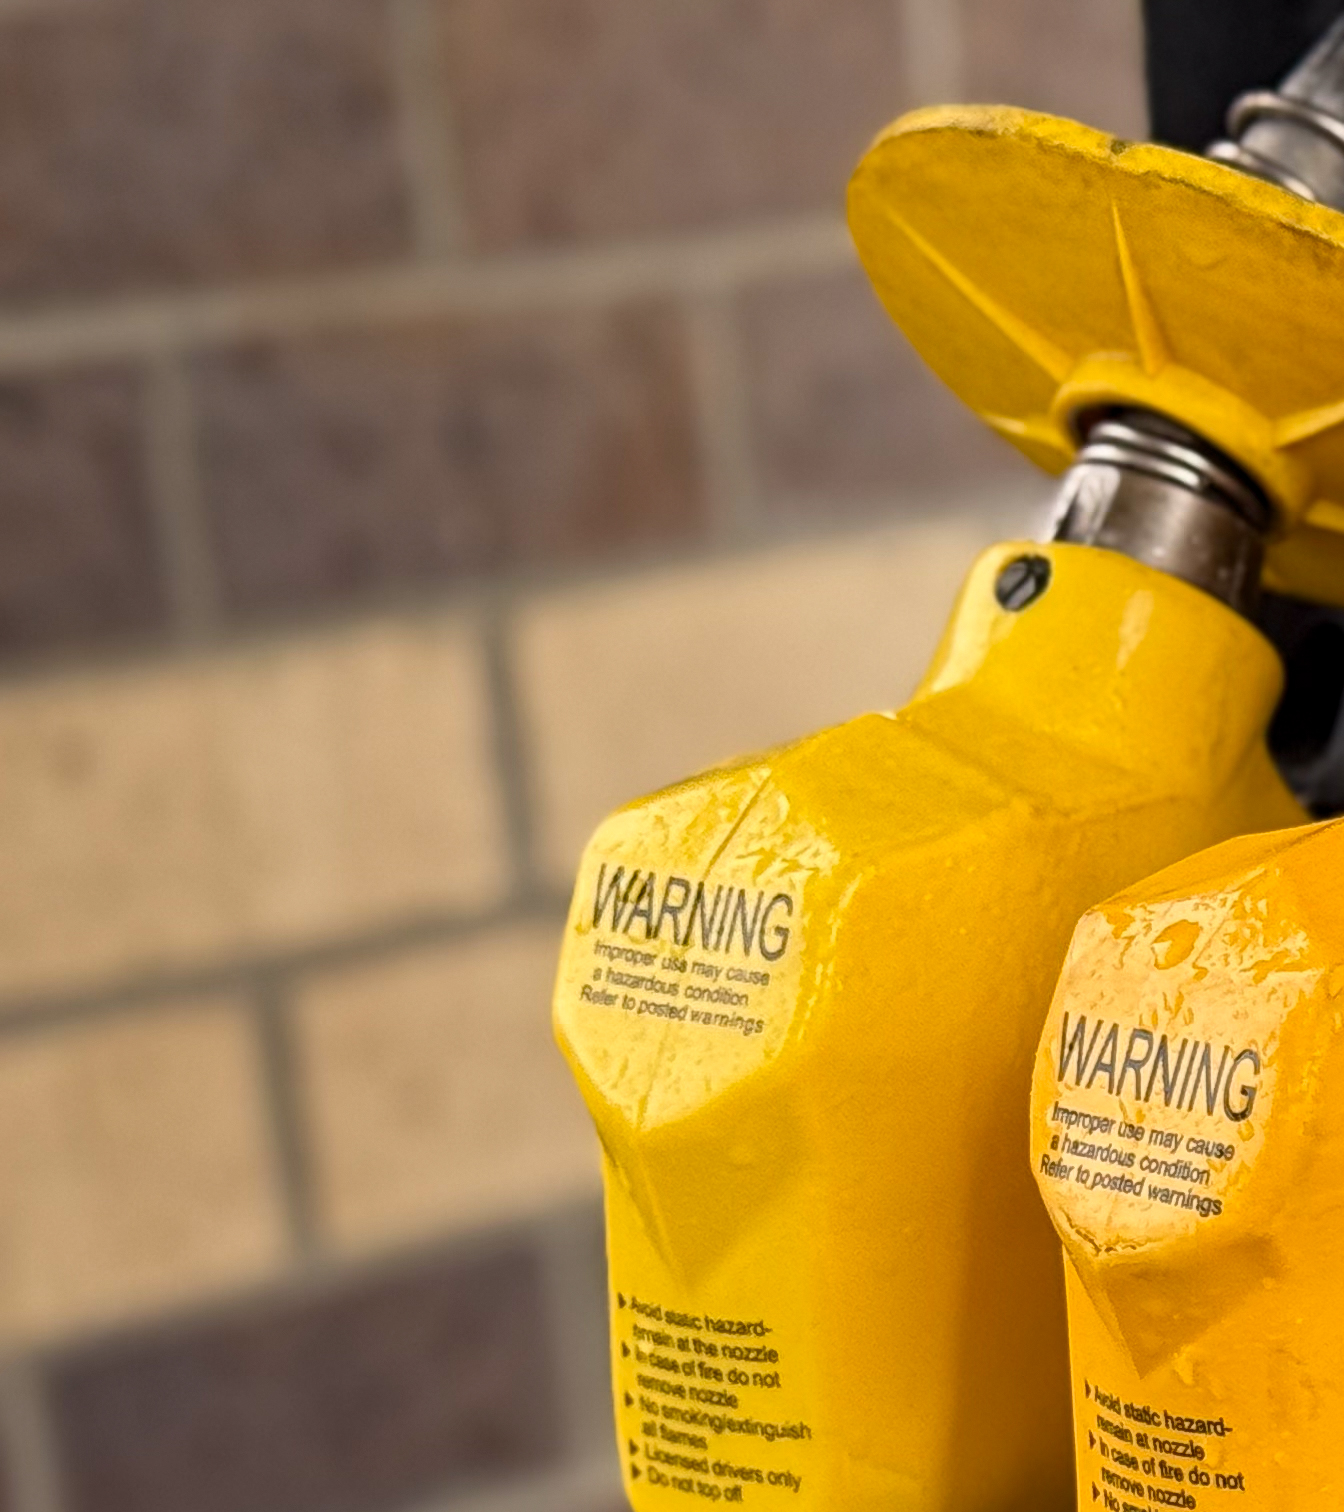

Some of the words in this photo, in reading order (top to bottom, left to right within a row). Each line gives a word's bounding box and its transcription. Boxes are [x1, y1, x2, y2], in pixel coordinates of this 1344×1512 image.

[592, 862, 794, 962] WARNING
[594, 940, 657, 967] Improper
[661, 955, 687, 973] use
[691, 958, 722, 982] may
[726, 967, 770, 986] cause
[593, 967, 602, 982] a
[605, 966, 680, 997] hazardous
[684, 985, 749, 1007] condition
[579, 983, 619, 1007] Refer
[622, 994, 636, 1010] to
[637, 998, 689, 1022] posted
[690, 1010, 764, 1036] warnings
[1057, 1011, 1261, 1122] WARNING
[1051, 1100, 1117, 1136] Improper
[1117, 1120, 1145, 1142] use
[1148, 1127, 1184, 1155] may
[1185, 1137, 1235, 1162] cause
[1050, 1134, 1060, 1150] a
[1061, 1133, 1136, 1169] hazardous
[1139, 1153, 1211, 1187] condition
[1040, 1154, 1075, 1179] Refer
[1075, 1167, 1089, 1184] to
[1092, 1172, 1146, 1197] posted
[1148, 1183, 1223, 1218] warnings
[704, 1315, 773, 1337] hazard-
[721, 1345, 780, 1363] nozzle
[688, 1386, 739, 1409] nozzle
[727, 1368, 750, 1386] do
[752, 1371, 781, 1389] not
[1123, 1401, 1162, 1427] static
[1163, 1409, 1233, 1437] hazard-
[644, 1442, 709, 1474] Licensed
[711, 1460, 764, 1483] drivers
[767, 1469, 802, 1493] only
[1099, 1437, 1110, 1458] In
[1110, 1447, 1139, 1471] case
[1142, 1457, 1157, 1477] of
[1158, 1460, 1184, 1483] fire
[1188, 1465, 1211, 1487] do
[1215, 1471, 1246, 1492] not
[1135, 1431, 1150, 1448] at
[1152, 1435, 1205, 1462] nozzle
[647, 1465, 670, 1488] Do
[671, 1476, 697, 1494] not
[724, 1484, 743, 1503] off
[1101, 1466, 1145, 1497] remove
[1147, 1483, 1197, 1510] nozzle
